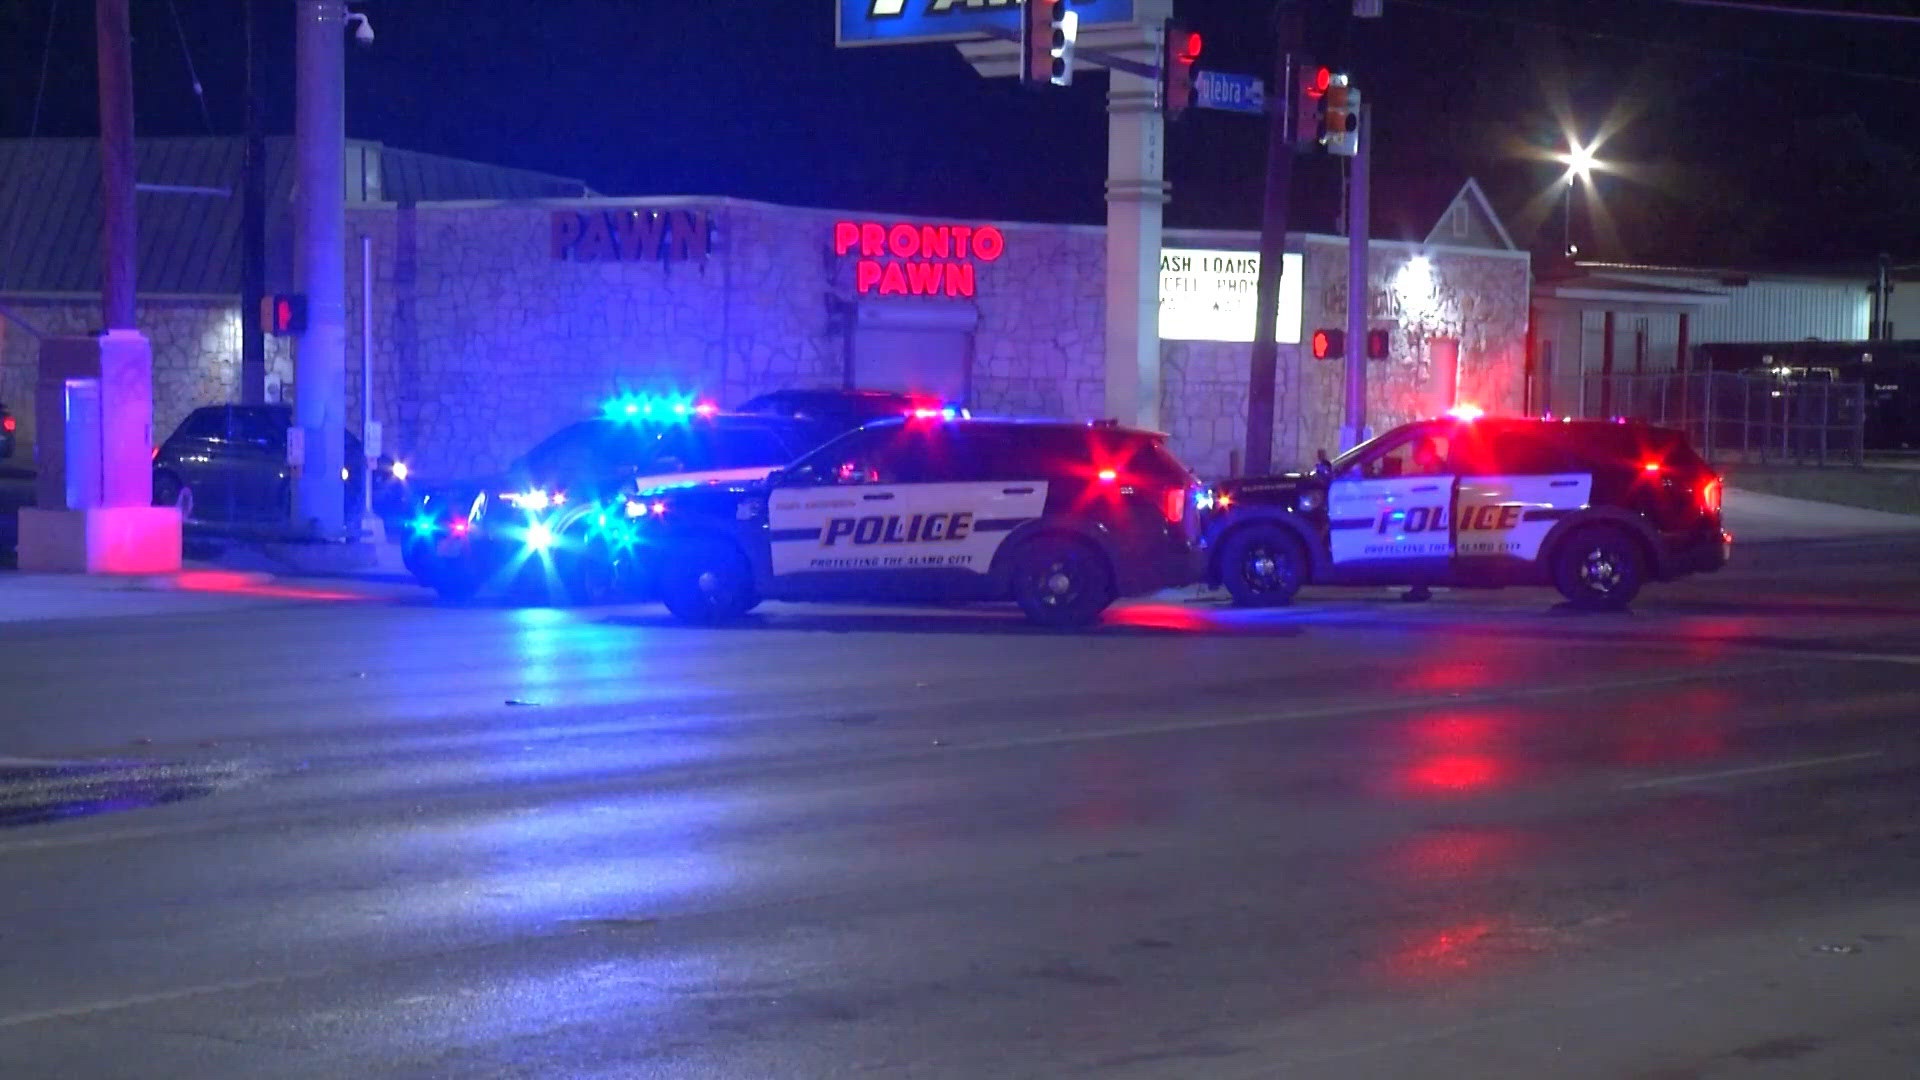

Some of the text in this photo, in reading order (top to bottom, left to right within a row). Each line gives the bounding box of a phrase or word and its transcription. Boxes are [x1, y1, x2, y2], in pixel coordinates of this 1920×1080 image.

[1203, 74, 1240, 105] ulebra
[550, 208, 712, 262] PAWN
[834, 221, 1004, 261] PRONTO
[857, 261, 976, 297] PAWN
[1160, 255, 1258, 274] ASH LOANS
[1217, 278, 1254, 294] PHO
[821, 511, 974, 548] POLICE
[1376, 504, 1523, 535] POLICE
[810, 555, 974, 568] PROTECTING THE ALAMO CITY
